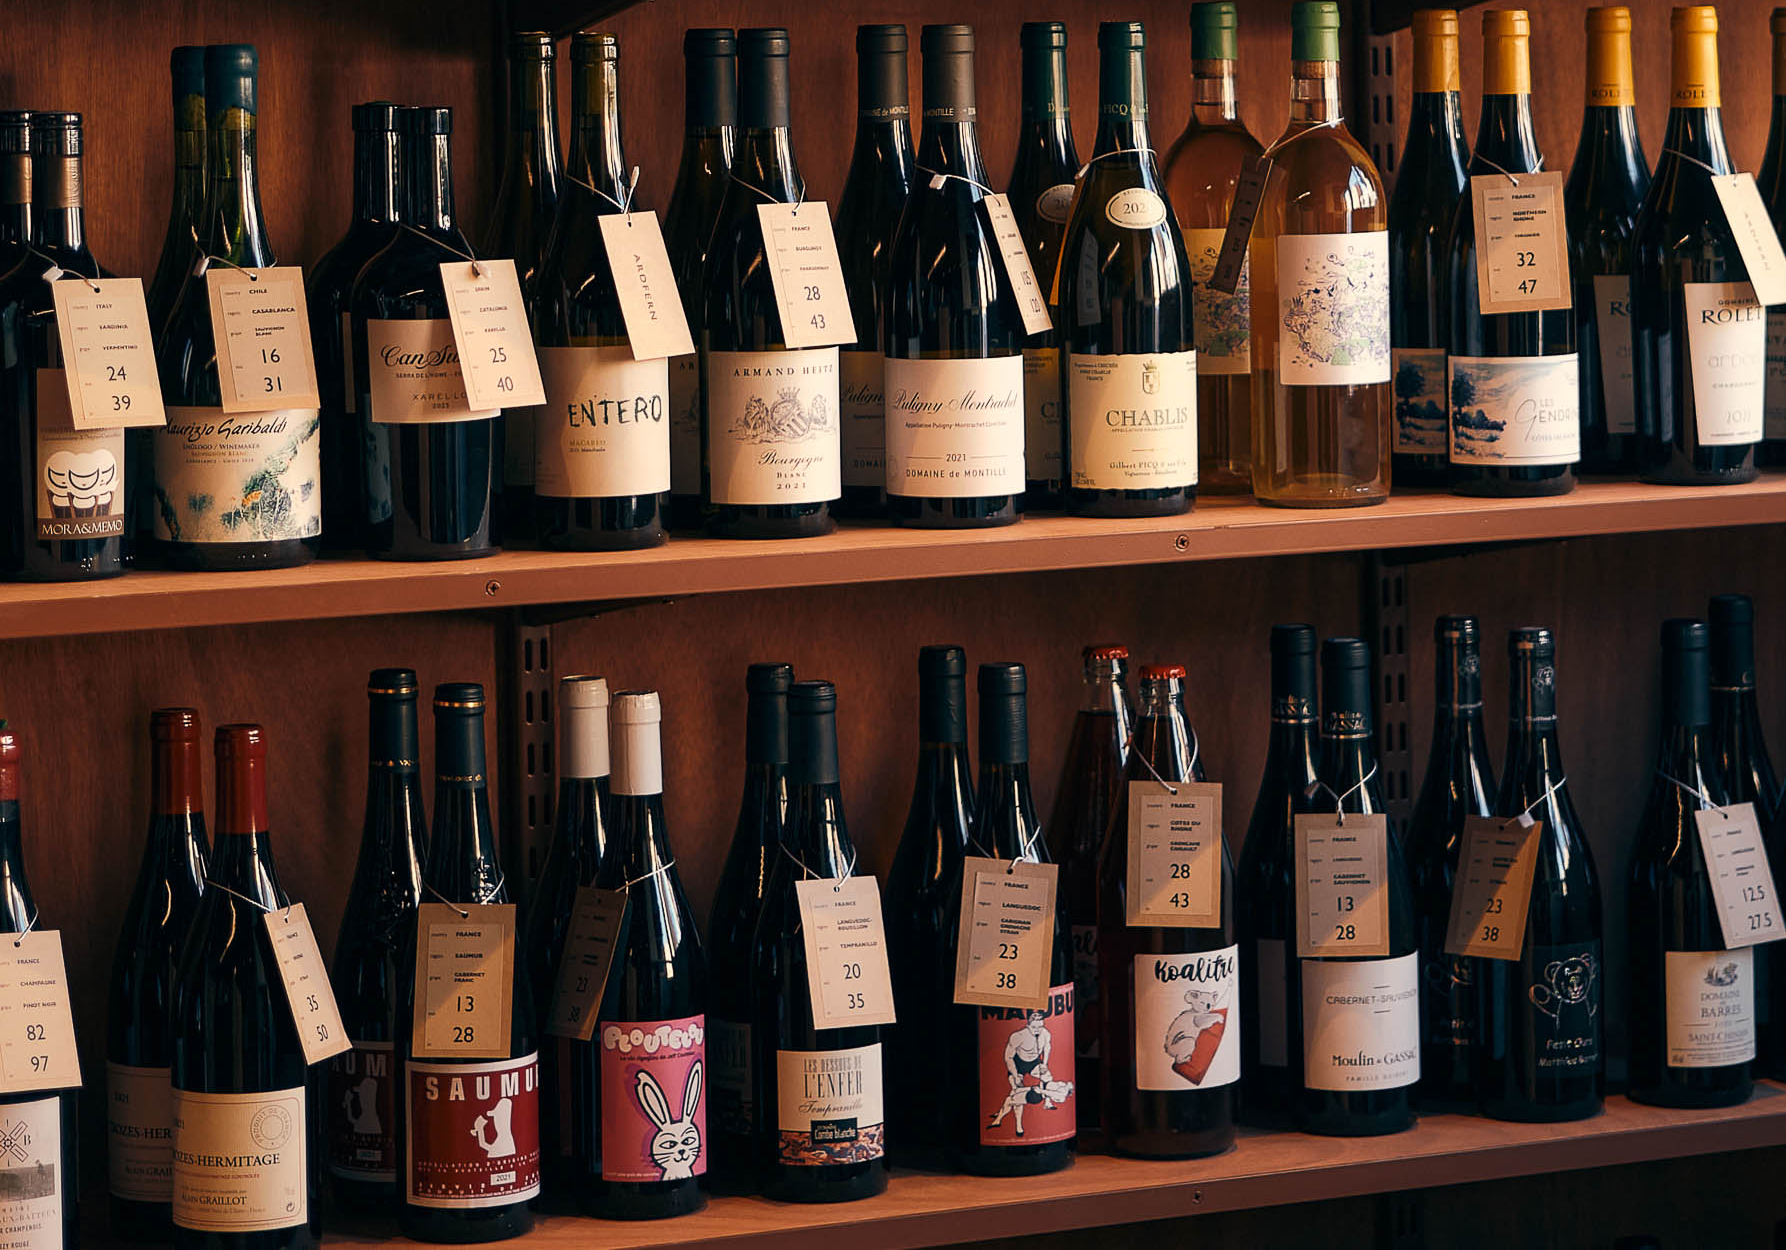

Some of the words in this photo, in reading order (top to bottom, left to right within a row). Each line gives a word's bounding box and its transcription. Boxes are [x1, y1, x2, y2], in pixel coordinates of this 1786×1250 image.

[1517, 252, 1536, 267] 32
[633, 253, 658, 321] ARDFERN
[804, 286, 820, 301] 28
[1518, 279, 1537, 294] 47
[252, 307, 296, 315] CASABLANCA
[1701, 306, 1762, 326] ROLET
[811, 314, 826, 329] 43
[262, 349, 280, 363] 16
[489, 348, 507, 363] 25
[107, 366, 126, 381] 24
[733, 367, 795, 377] ARMAND
[803, 365, 833, 375] HEITZ
[264, 377, 282, 392] 31
[497, 377, 513, 391] 40
[112, 395, 131, 411] 39
[568, 395, 662, 427] ENTERO
[1106, 408, 1187, 427] CHABLIS
[217, 419, 287, 441] Garibaldi
[946, 453, 967, 462] 2021
[906, 469, 945, 478] DOMAINE
[42, 519, 123, 536] MORA&MEMO
[1170, 864, 1190, 879] 28
[1170, 893, 1189, 908] 43
[1743, 886, 1765, 902] 12.5
[1002, 903, 1041, 911] LANGUEDOC
[1337, 897, 1354, 911] 13
[1486, 899, 1502, 913] 23
[1748, 914, 1772, 931] 27.5
[1336, 926, 1356, 940] 28
[1482, 927, 1499, 941] 38
[840, 941, 878, 949] TEMPRANILLO
[999, 944, 1018, 959] 23
[843, 964, 861, 979] 20
[996, 973, 1016, 989] 38
[307, 995, 319, 1012] 35
[456, 996, 474, 1012] 13
[848, 994, 865, 1009] 35
[27, 1024, 46, 1040] 82
[317, 1025, 328, 1042] 50
[453, 1027, 474, 1042] 28
[31, 1055, 48, 1071] 97
[803, 1059, 817, 1072] LES
[1333, 1051, 1374, 1067] Moulin
[803, 1070, 863, 1099] L'ENFER
